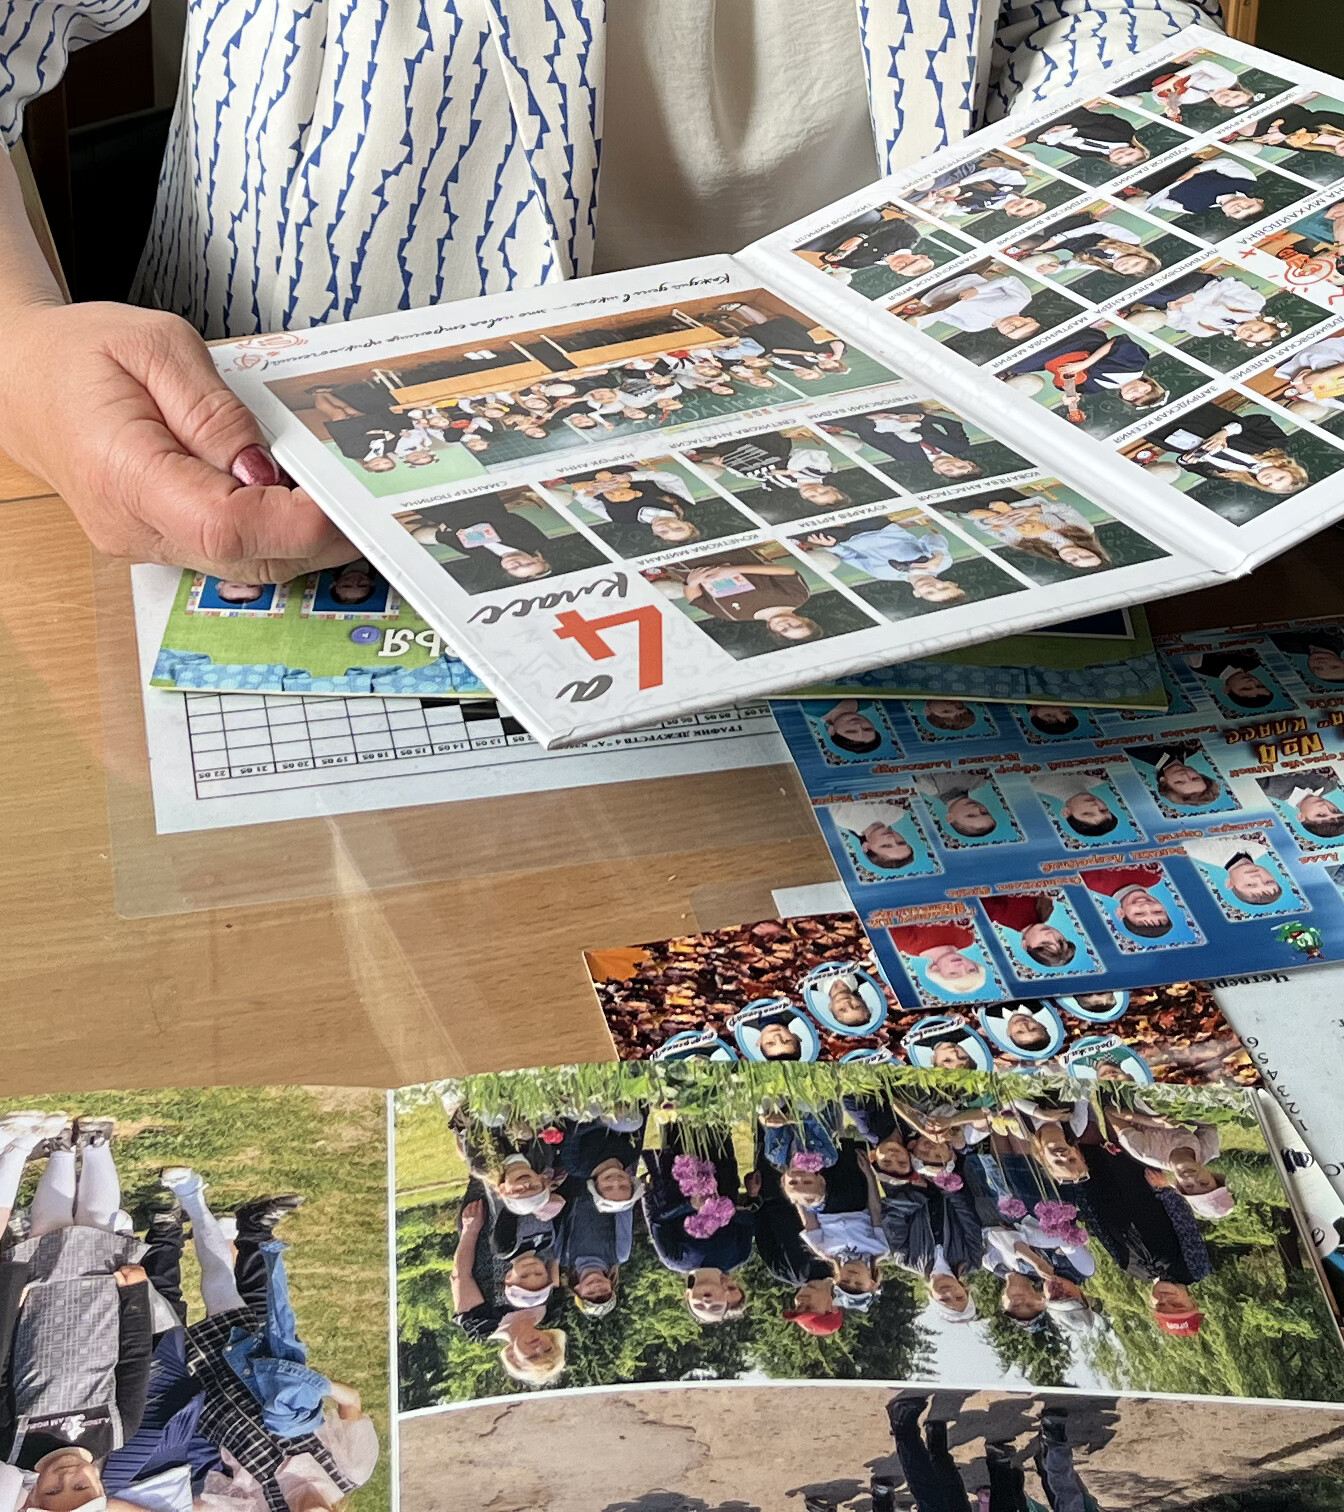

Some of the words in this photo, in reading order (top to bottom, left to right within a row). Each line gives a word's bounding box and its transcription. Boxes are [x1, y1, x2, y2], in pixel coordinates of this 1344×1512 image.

[467, 572, 628, 624] класс
[552, 610, 663, 690] 4
[1222, 715, 1308, 744] КЛАСС
